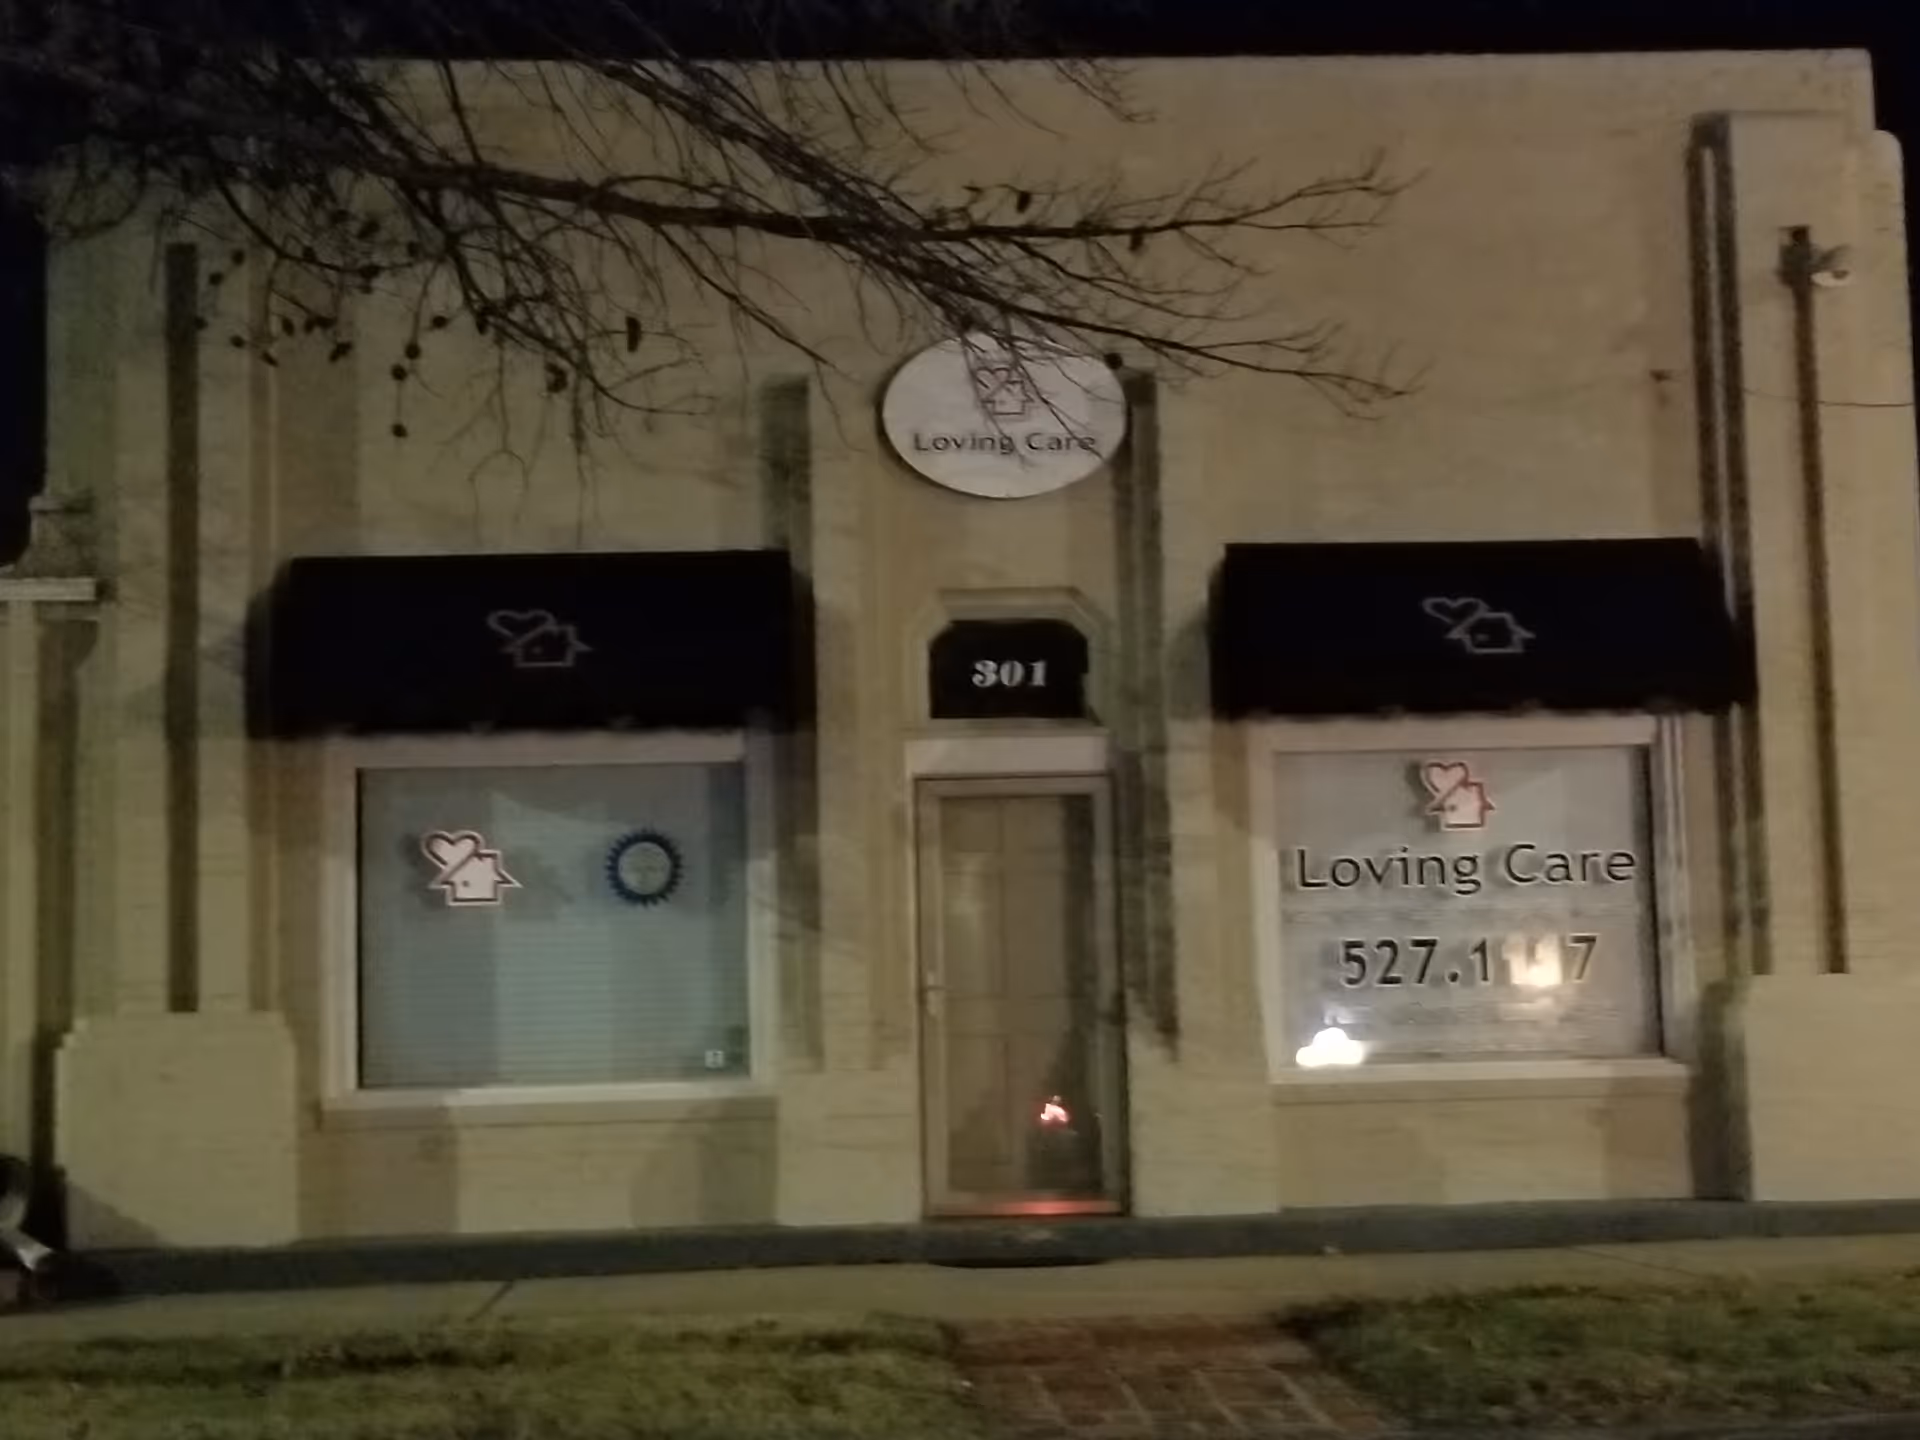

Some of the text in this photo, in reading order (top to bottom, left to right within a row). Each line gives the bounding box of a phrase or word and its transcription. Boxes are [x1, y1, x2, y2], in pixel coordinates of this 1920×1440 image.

[913, 431, 1097, 454] Loving Care
[971, 659, 1047, 688] 301
[1298, 843, 1636, 895] Loving Care
[1342, 935, 1598, 986] 527.17
